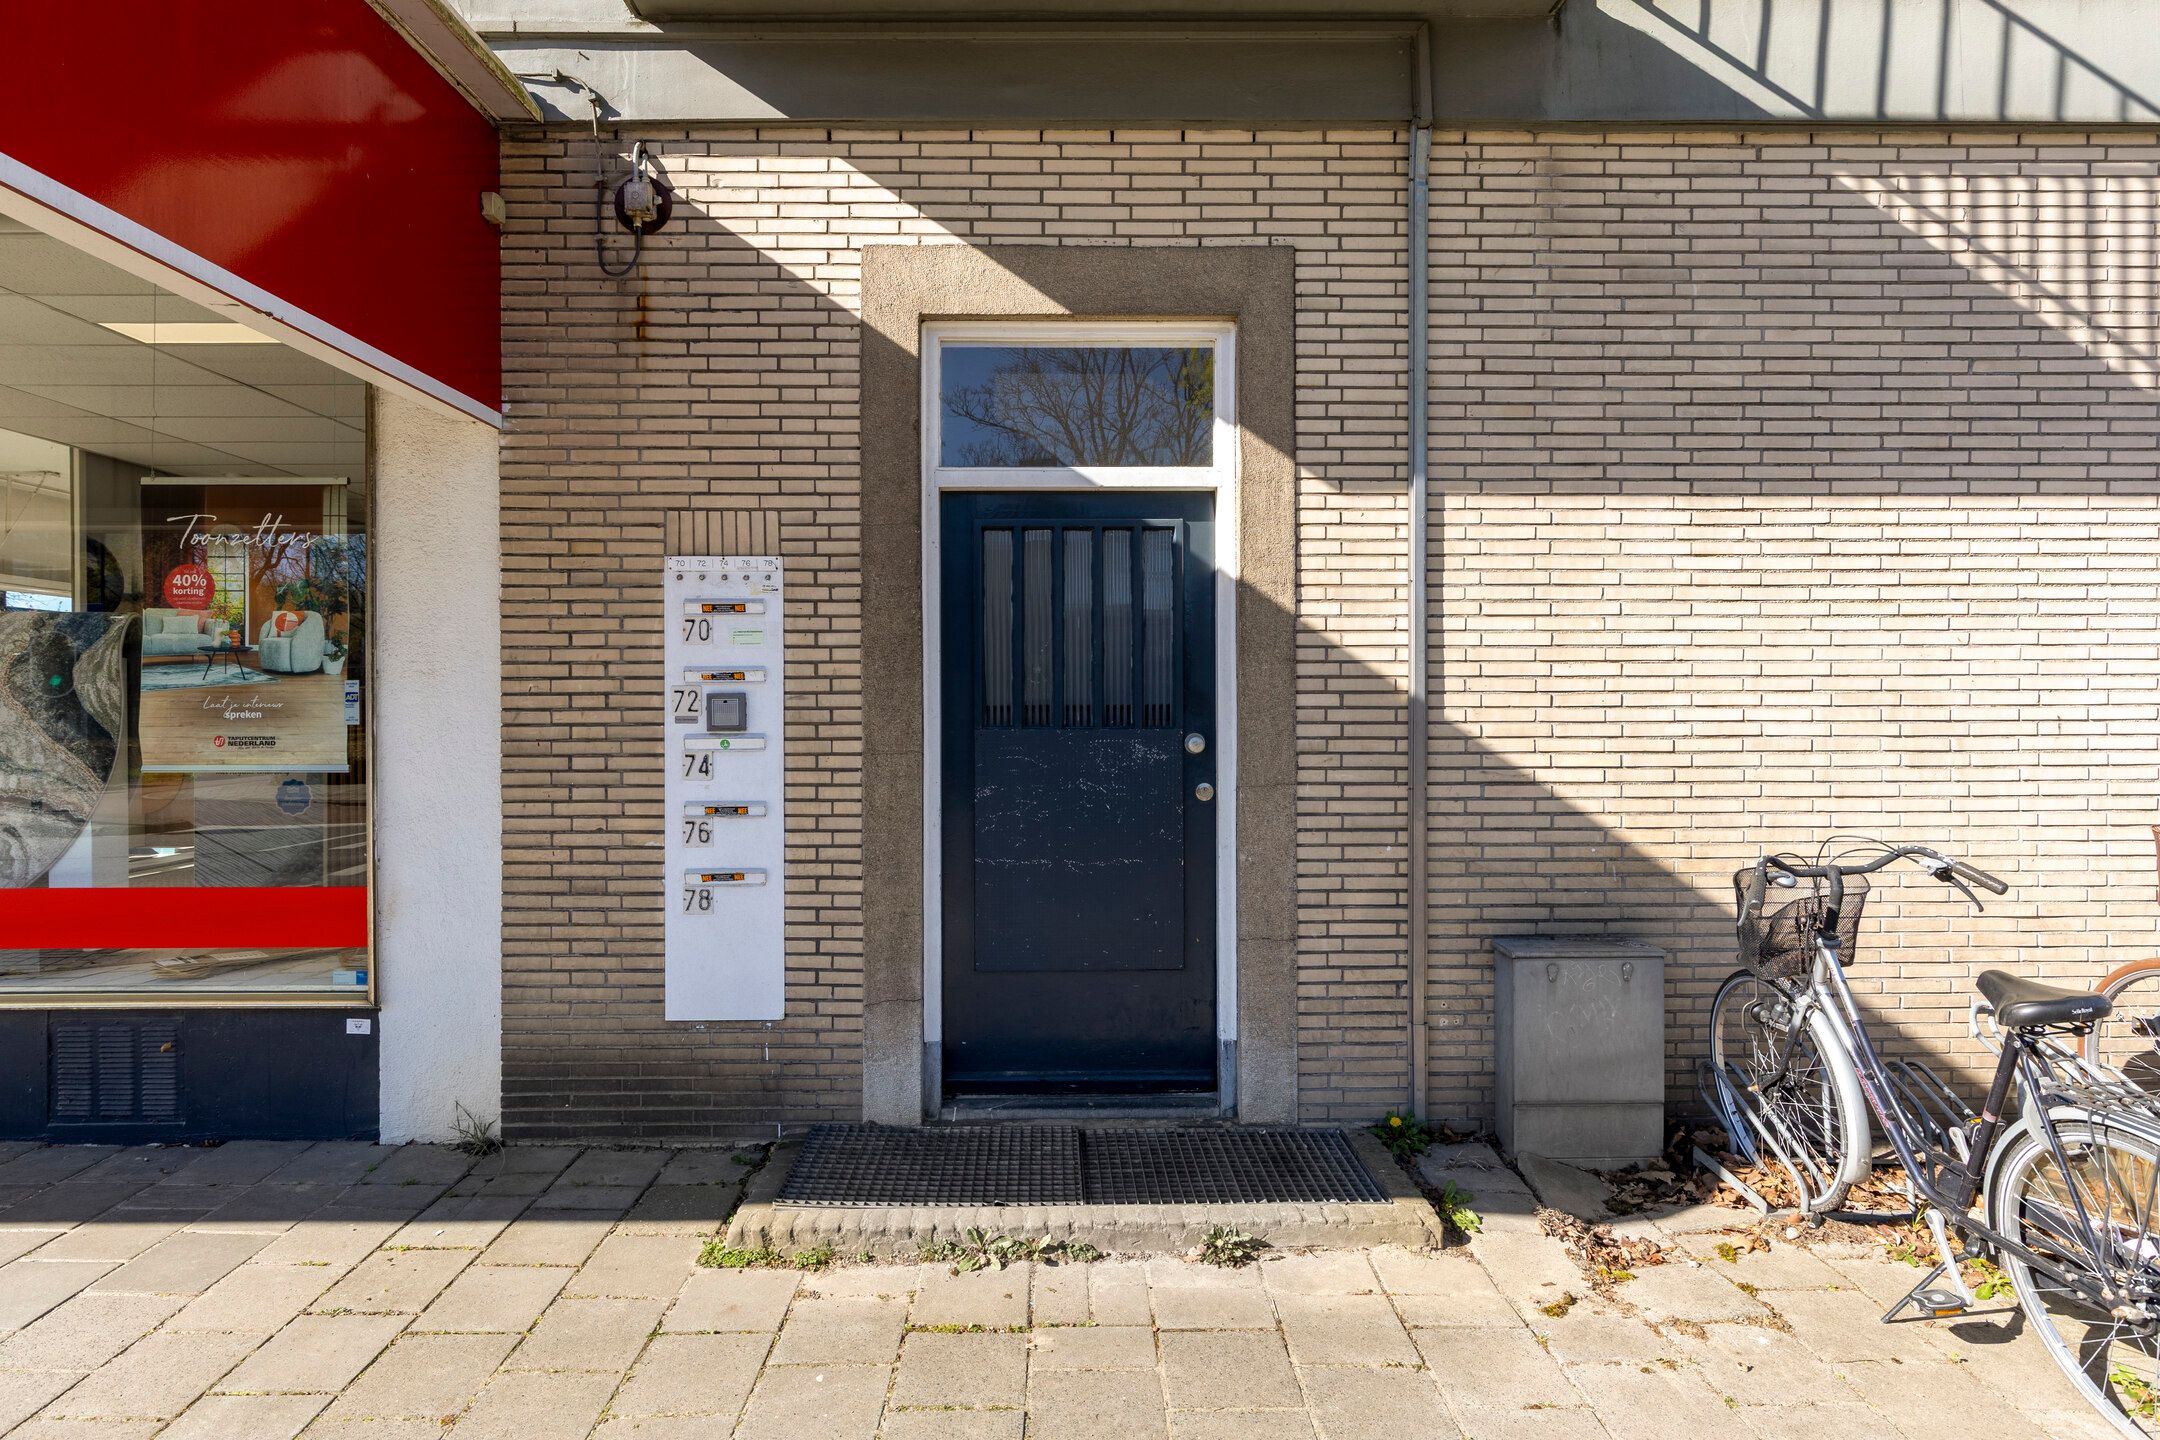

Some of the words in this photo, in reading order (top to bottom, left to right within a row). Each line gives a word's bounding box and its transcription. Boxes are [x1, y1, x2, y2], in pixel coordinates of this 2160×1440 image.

[166, 512, 321, 549] Toonzetters
[172, 574, 207, 587] 40%
[684, 619, 710, 642] 70
[203, 695, 230, 709] Laat
[673, 690, 699, 713] 72
[225, 710, 262, 720] spreken
[684, 754, 710, 777] 74
[684, 821, 711, 844] 76
[684, 888, 711, 912] 78
